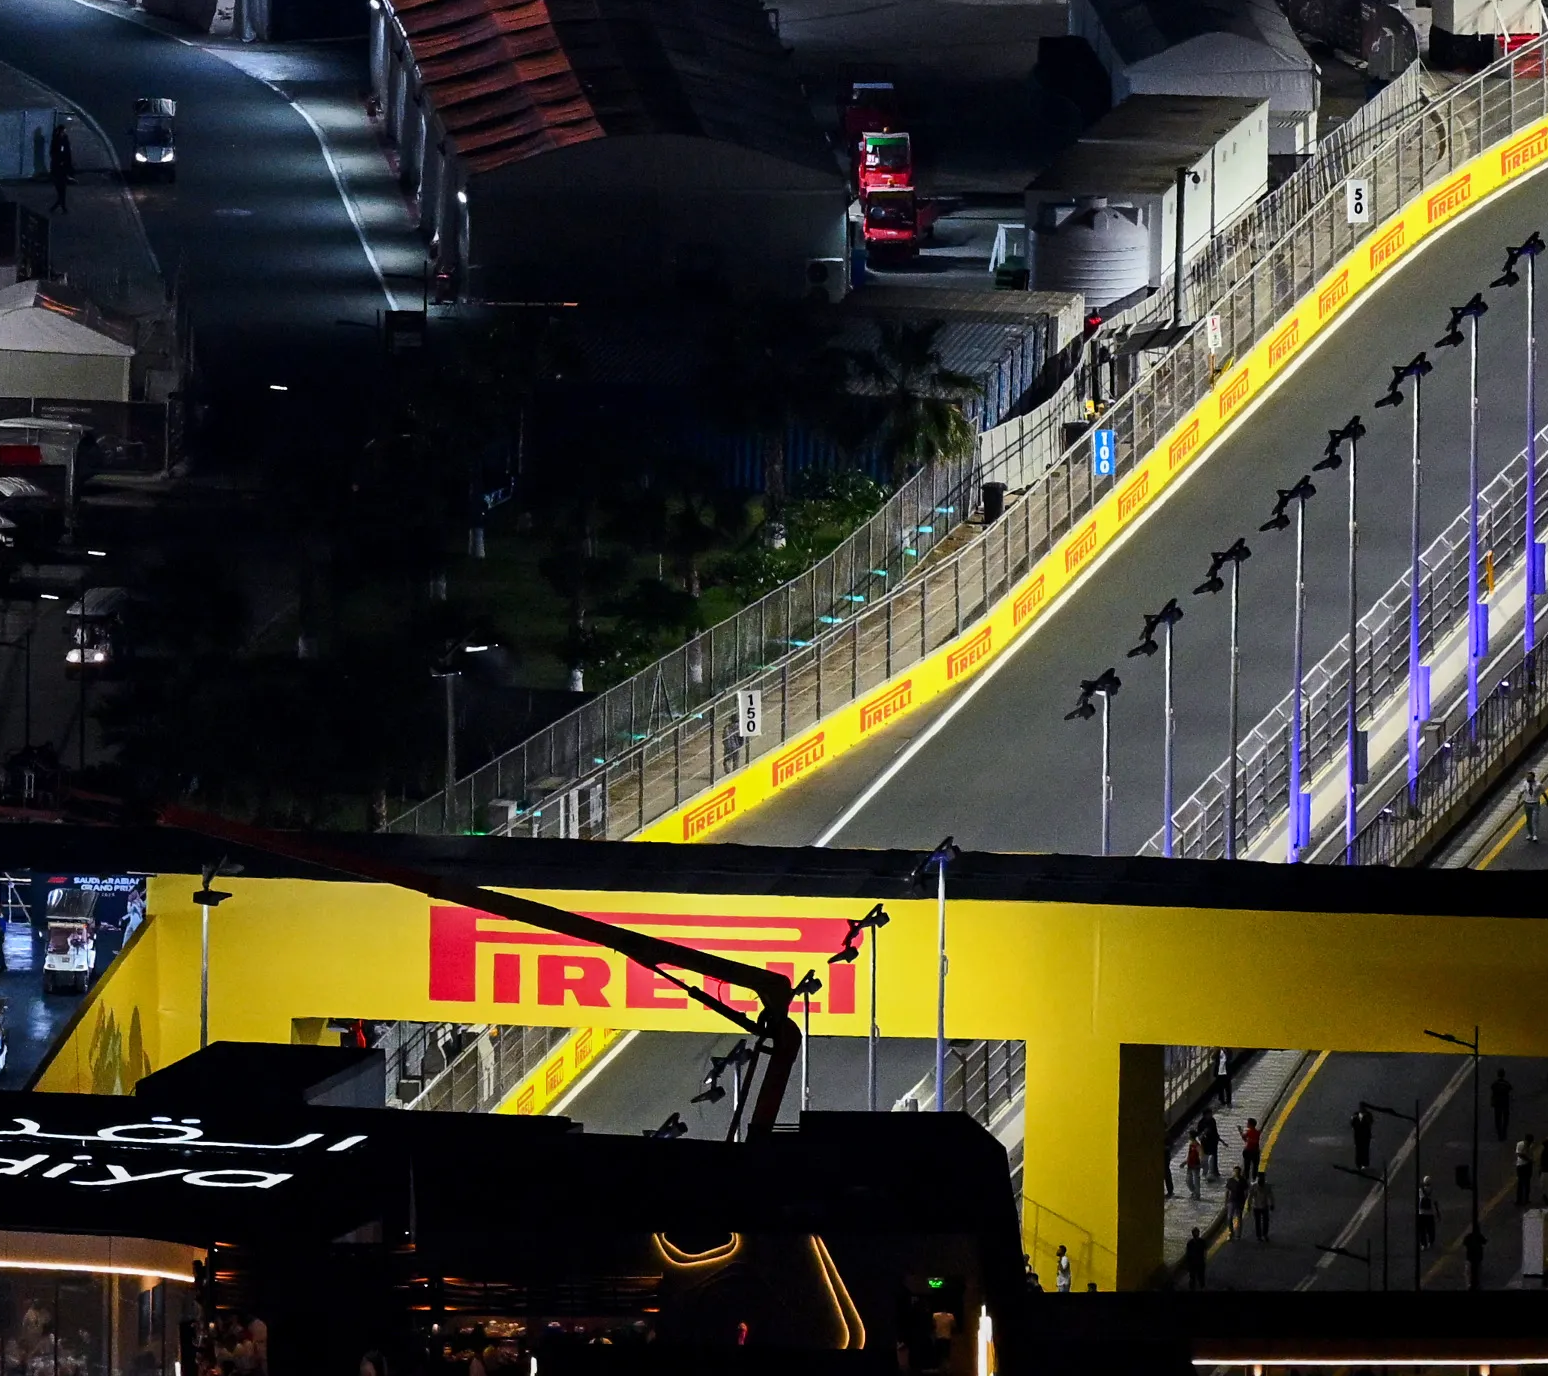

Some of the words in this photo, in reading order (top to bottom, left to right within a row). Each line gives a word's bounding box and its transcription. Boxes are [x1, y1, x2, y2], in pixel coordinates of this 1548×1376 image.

[1501, 127, 1548, 176] PIRELLI
[1354, 187, 1363, 215] 50
[1428, 174, 1470, 222] PIRELLI
[1370, 221, 1404, 270] PIRELLI
[1319, 270, 1348, 319] PIRELLI
[1267, 319, 1299, 368] PIRELLI
[1100, 431, 1110, 473] 100
[947, 626, 992, 680] PIRELLI
[745, 694, 756, 733] 150
[860, 680, 912, 733] PIRELLI
[773, 732, 824, 787] PIRELLI
[683, 787, 736, 840] PIRELLI
